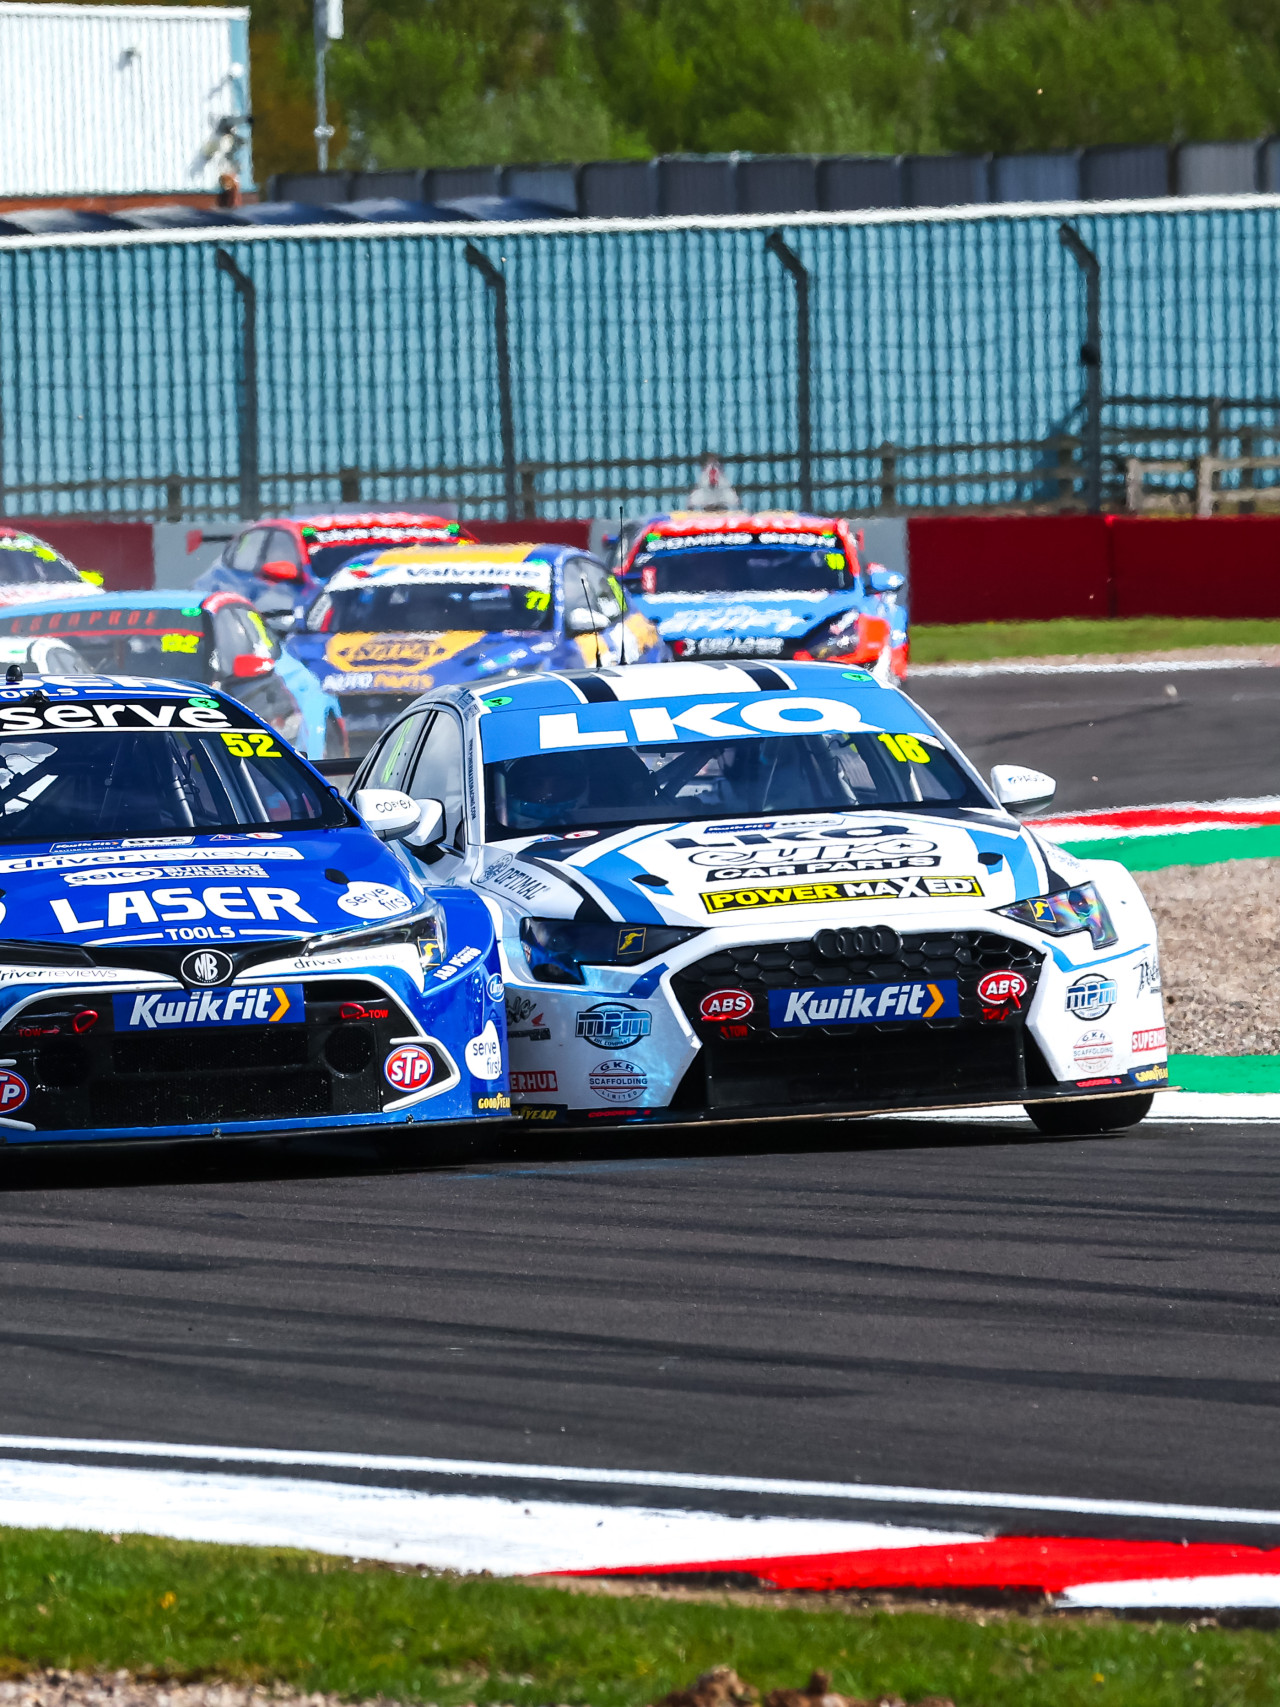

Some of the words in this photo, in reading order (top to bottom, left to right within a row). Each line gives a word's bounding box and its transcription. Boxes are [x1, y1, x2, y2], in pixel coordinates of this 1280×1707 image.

[524, 591, 551, 611] 77
[538, 697, 862, 750] LKQ
[221, 733, 282, 758] 52
[665, 826, 917, 849] LKQ
[72, 867, 153, 884] selco
[714, 865, 801, 879] CAR
[807, 856, 937, 874] PARTS
[493, 867, 542, 901] OPTIMAL
[713, 884, 839, 910] POWER
[845, 876, 973, 899] MAXED
[345, 886, 389, 907] serve
[49, 886, 318, 933] LASER
[164, 926, 236, 941] TOOLS
[985, 979, 1021, 995] ABS
[129, 988, 271, 1028] KwikFit
[369, 1009, 389, 1019] TOW
[708, 996, 746, 1013] ABS
[783, 985, 926, 1025] KwikFit
[19, 1028, 42, 1038] TOW
[472, 1040, 497, 1057] serve
[391, 1052, 428, 1085] STP
[600, 1061, 635, 1073] GKR
[510, 1073, 558, 1090] ERHUB
[589, 1077, 648, 1085] SCAFFOLDING
[601, 1090, 638, 1100] LIMITED
